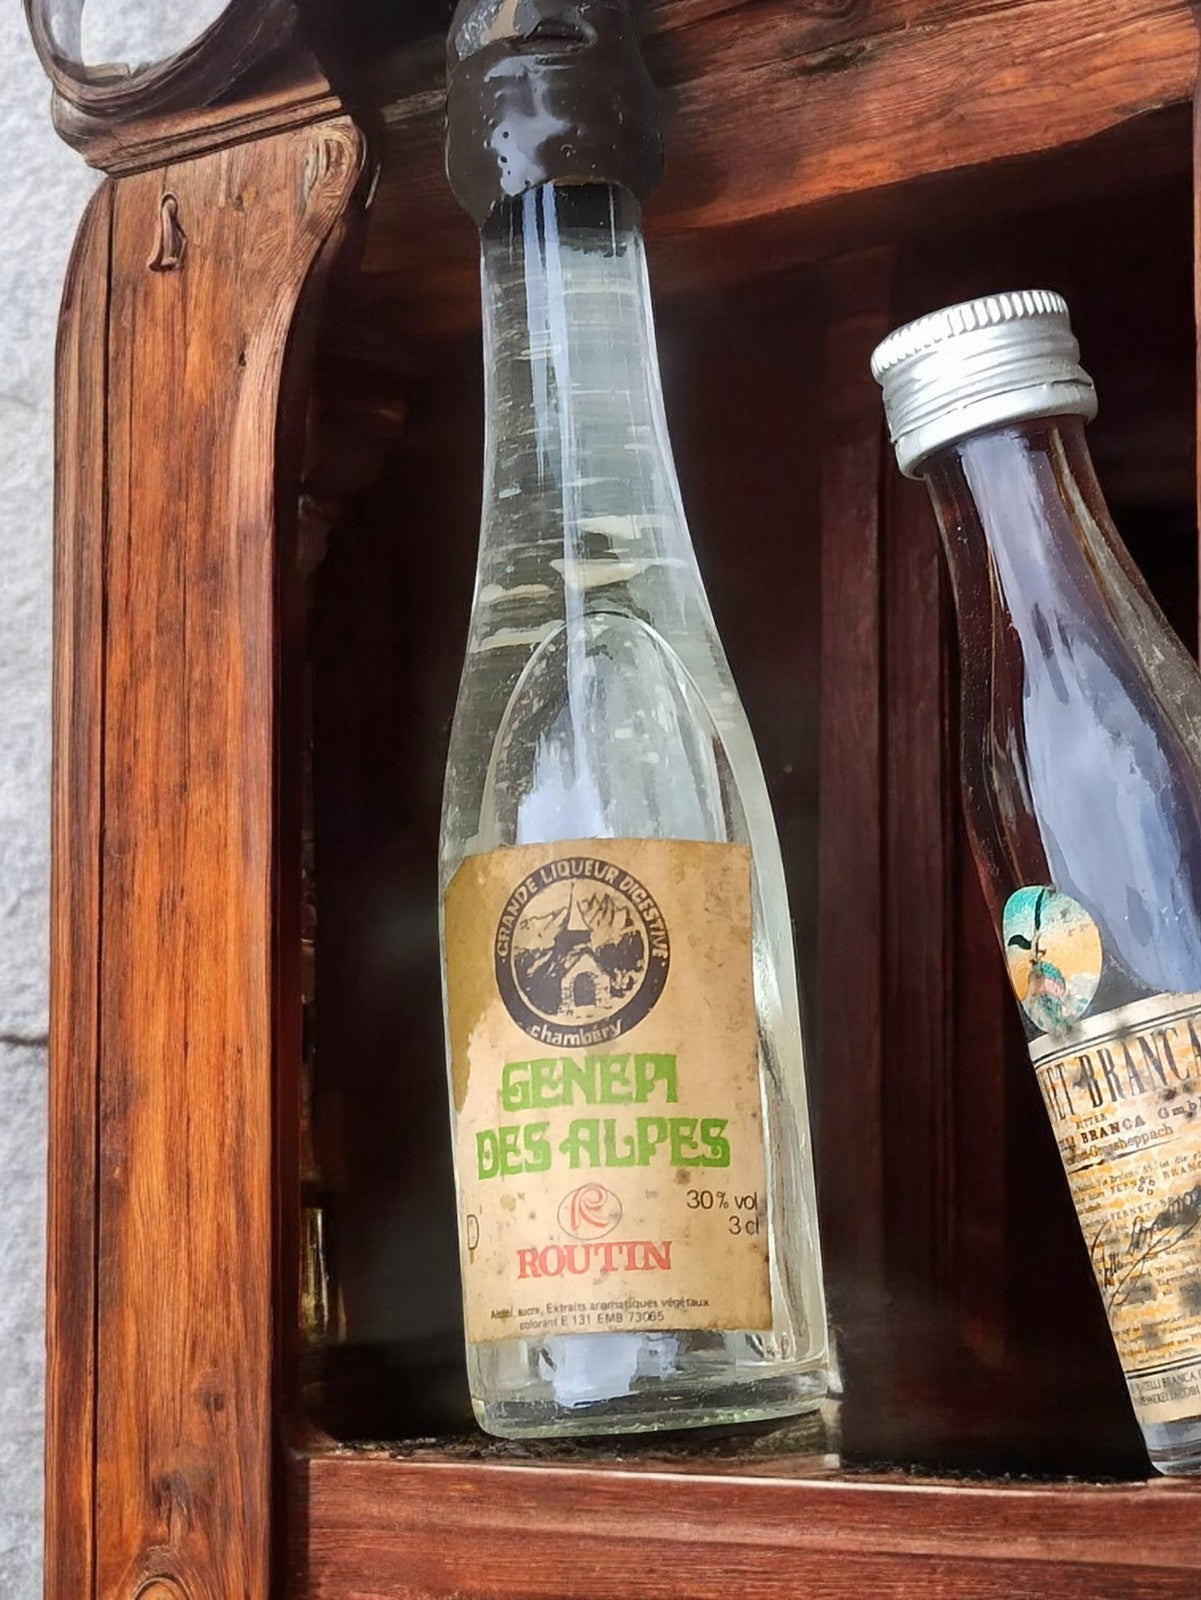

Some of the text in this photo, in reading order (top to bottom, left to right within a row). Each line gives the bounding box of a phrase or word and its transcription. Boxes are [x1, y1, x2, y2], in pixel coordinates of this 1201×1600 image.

[497, 859, 669, 959] GRANDE LIQUEUR DIGESTIVE
[501, 1053, 679, 1112] GENEPI
[1081, 1114, 1146, 1144] BRANCA
[475, 1117, 731, 1180] DES ALPES
[734, 1191, 758, 1211] vol
[728, 1215, 760, 1235] 3 cl
[516, 1240, 673, 1280] ROUTIN
[560, 1316, 569, 1327] E
[573, 1314, 592, 1326] 131
[597, 1312, 623, 1324] EMB
